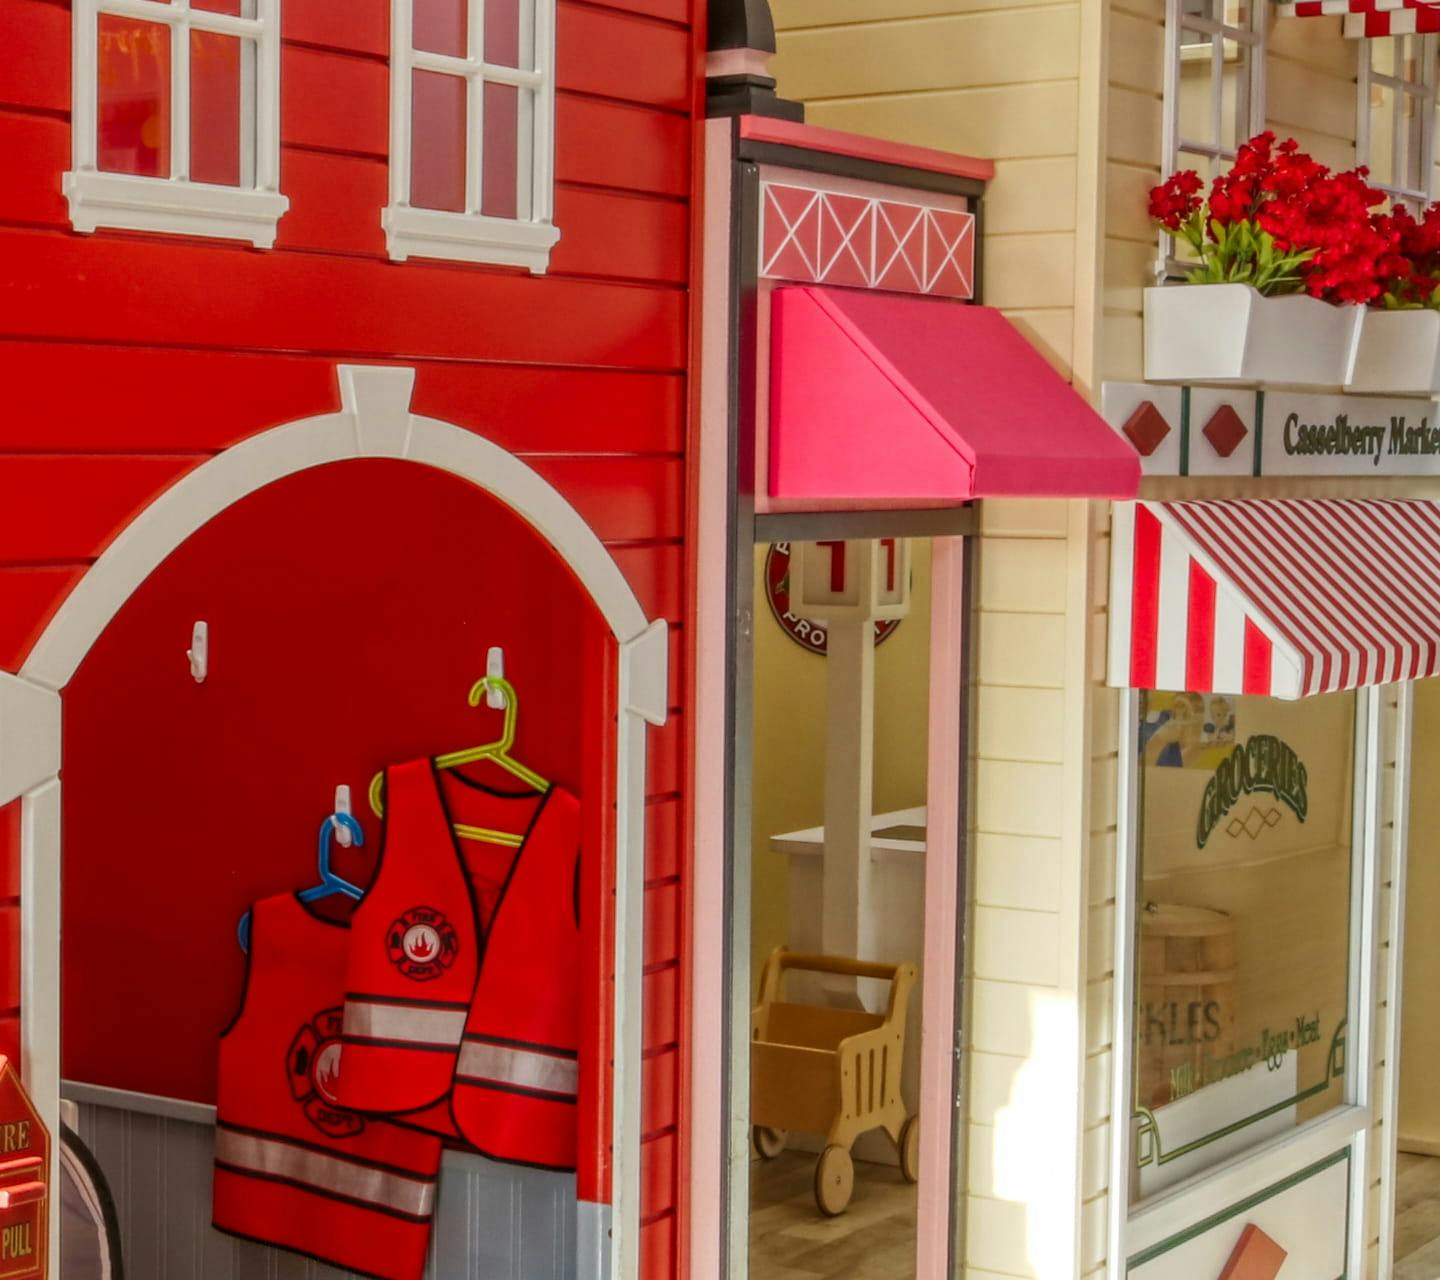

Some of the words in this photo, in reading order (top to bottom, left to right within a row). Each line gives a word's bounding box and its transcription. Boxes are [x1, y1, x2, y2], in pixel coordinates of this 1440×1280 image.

[1283, 411, 1386, 466] Casselberry
[1196, 734, 1309, 850] GROCERIES
[1, 1223, 32, 1261] PULL
